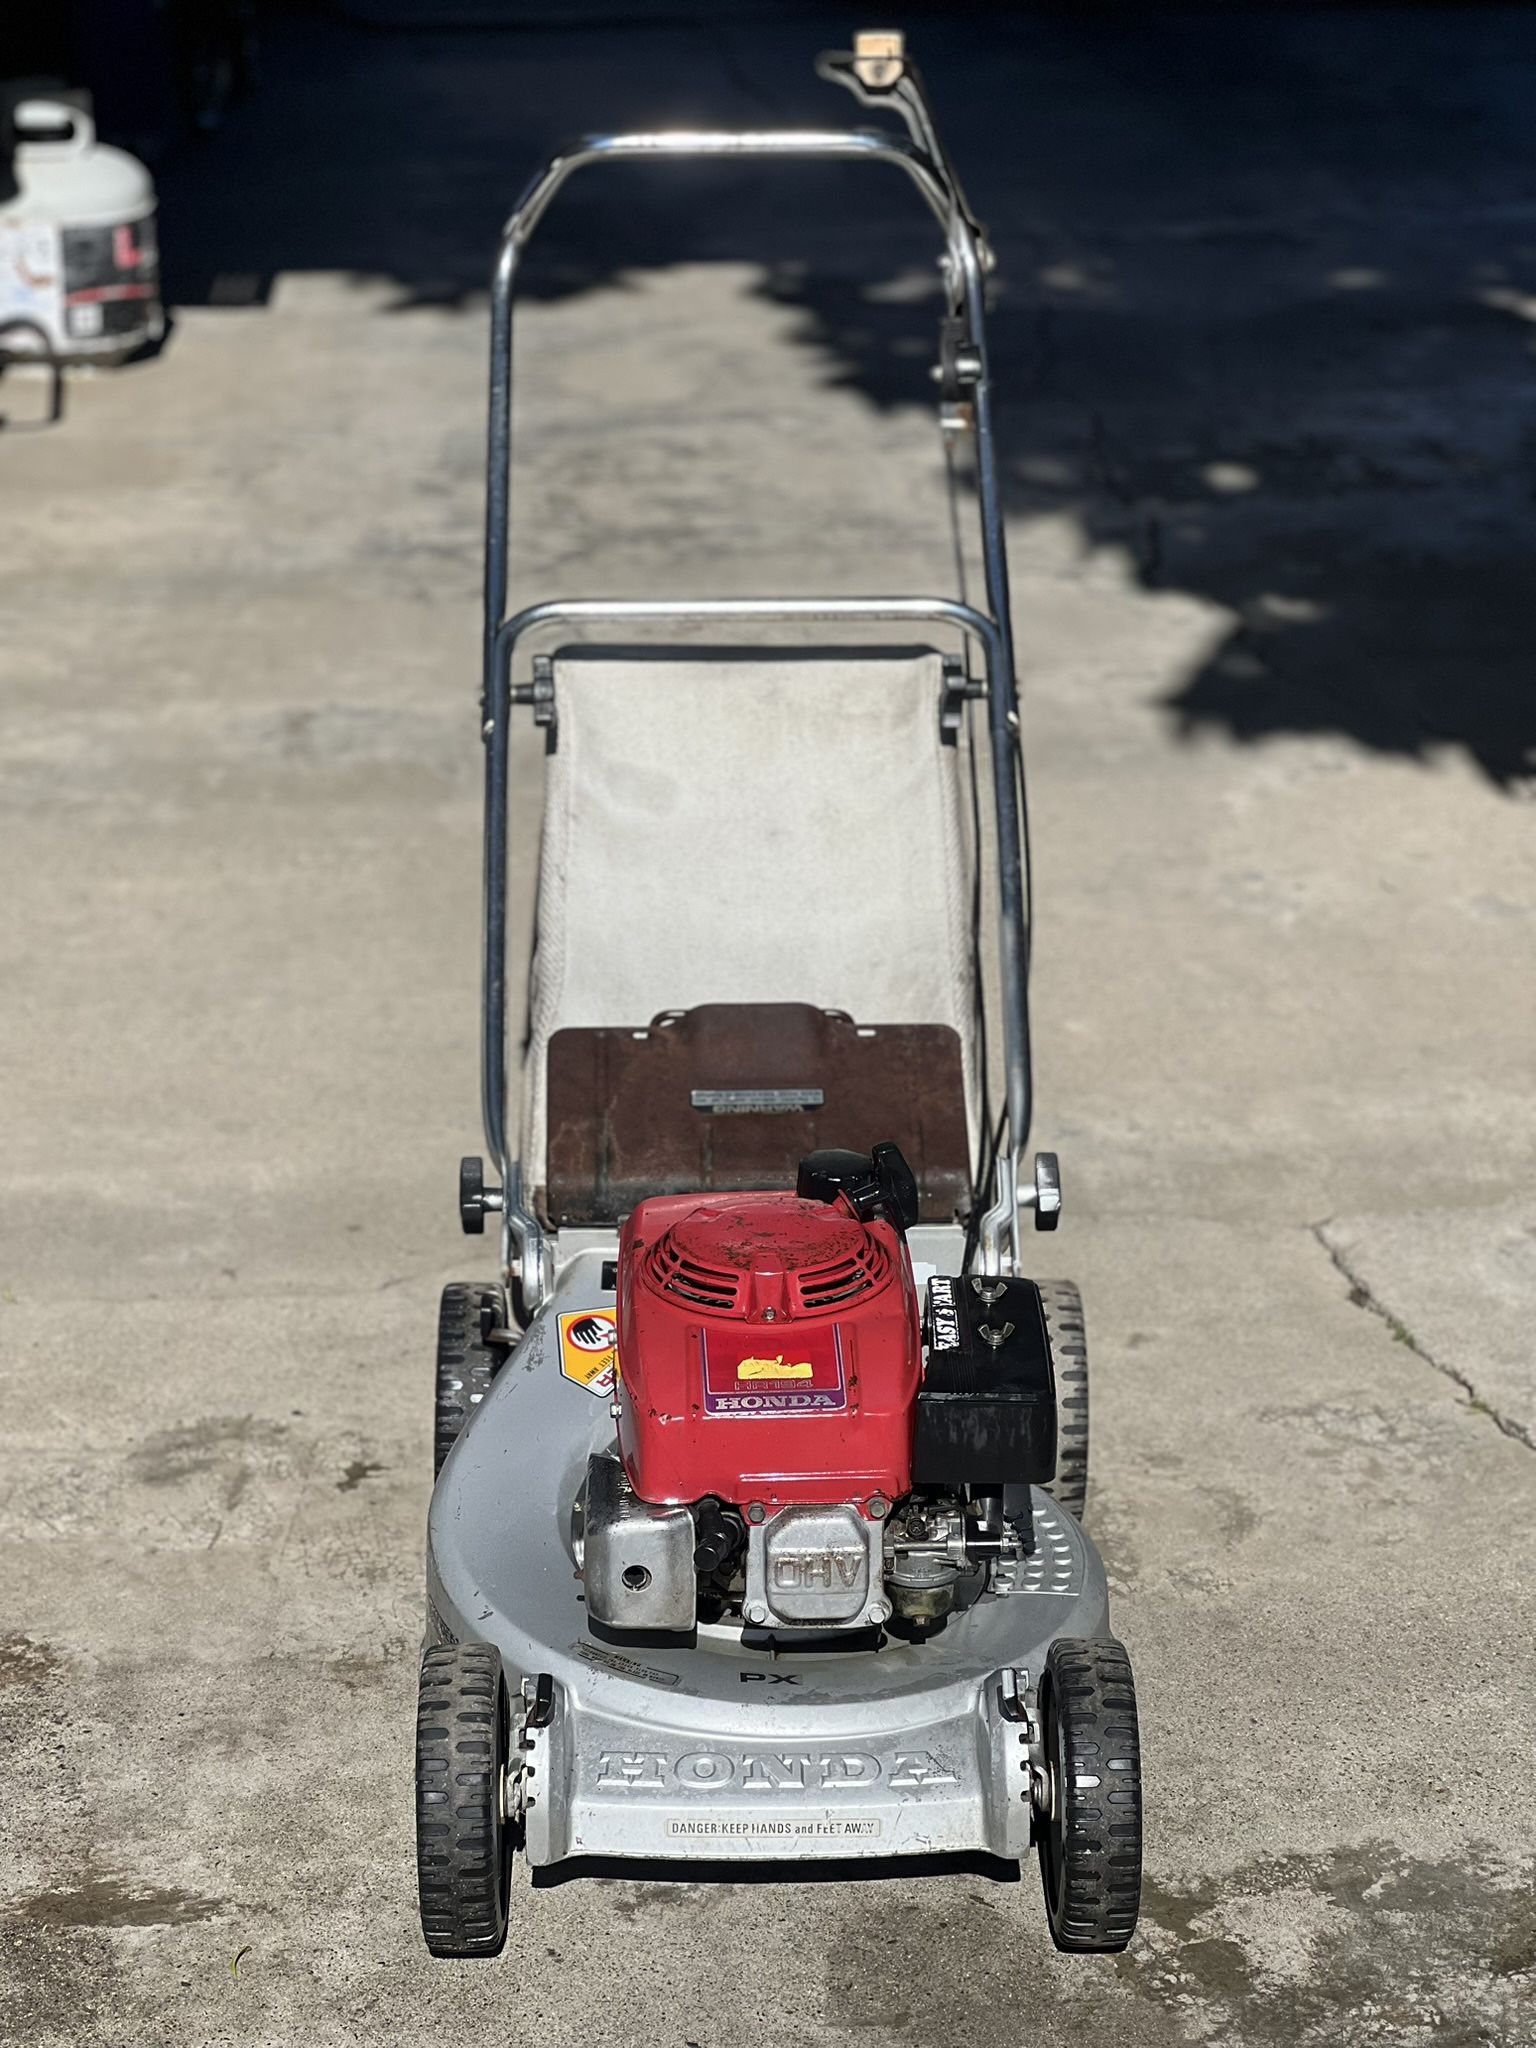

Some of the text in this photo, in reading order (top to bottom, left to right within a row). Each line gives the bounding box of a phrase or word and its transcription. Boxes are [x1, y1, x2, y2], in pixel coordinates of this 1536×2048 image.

[712, 1104, 804, 1114] WARNING
[715, 1395, 836, 1409] HONDA
[774, 1556, 862, 1588] OHV
[740, 1672, 800, 1685] PX
[596, 1750, 958, 1788] HONDA
[751, 1823, 792, 1835] HANDS
[794, 1823, 814, 1835] and
